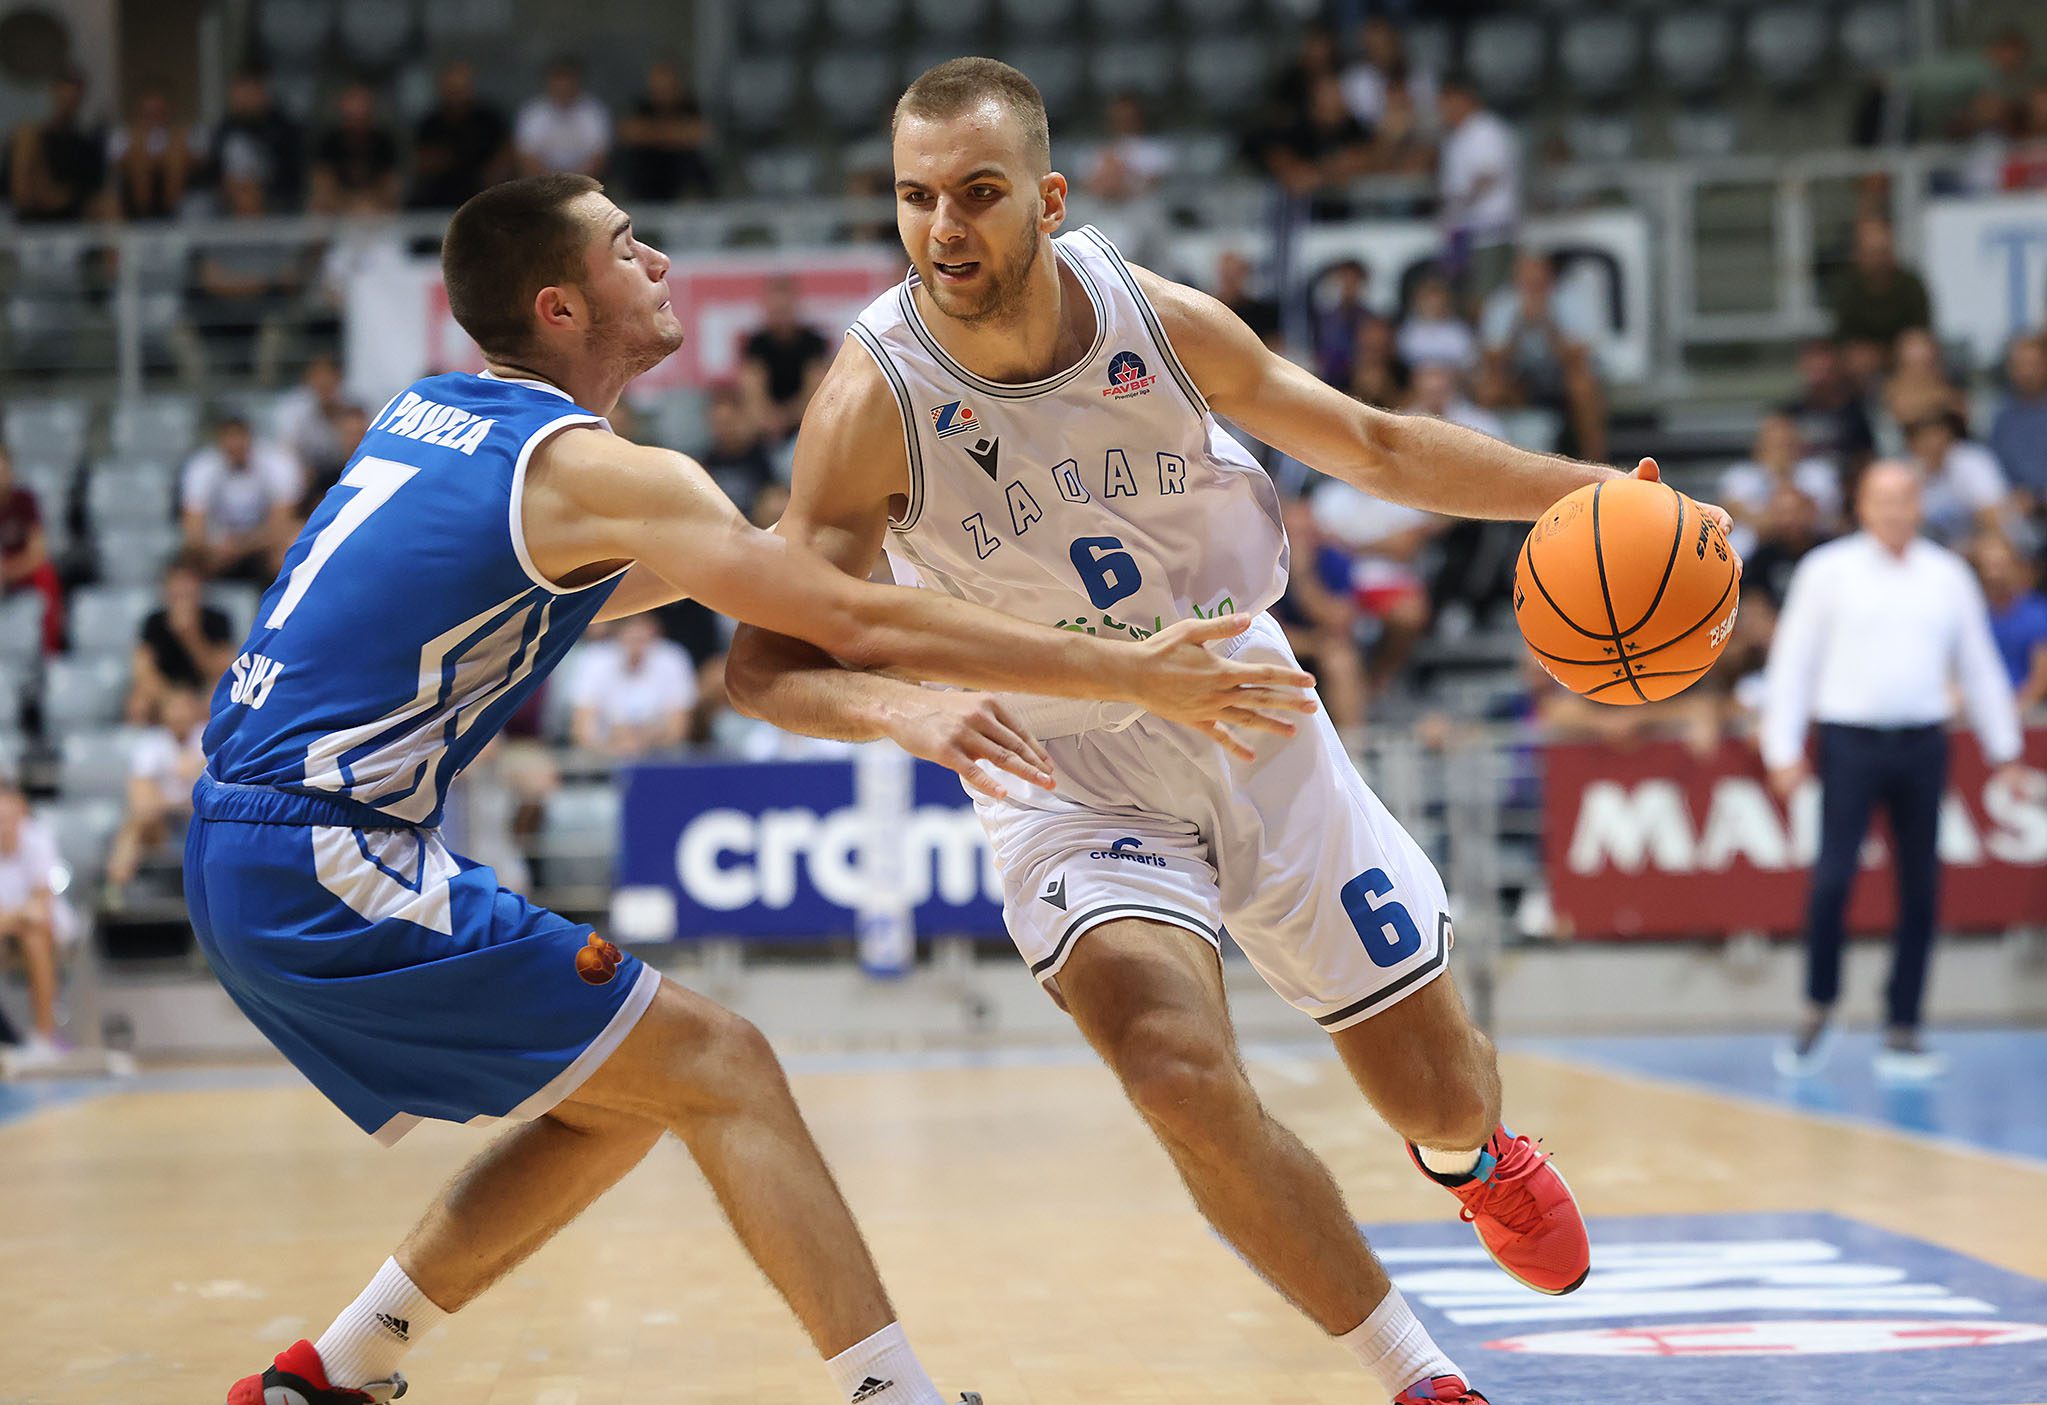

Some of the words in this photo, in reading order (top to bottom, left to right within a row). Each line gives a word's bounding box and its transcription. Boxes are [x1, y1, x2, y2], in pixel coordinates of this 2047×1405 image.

[1103, 375, 1156, 397] FAVBET
[377, 391, 500, 456] PAVELA
[962, 449, 1186, 560] ZADAR
[264, 455, 422, 630] 7
[1069, 536, 1142, 610] 6
[1090, 851, 1167, 867] cromaris
[1340, 867, 1422, 968] 6
[376, 1313, 409, 1341] adidas
[851, 1380, 894, 1404] adidas
